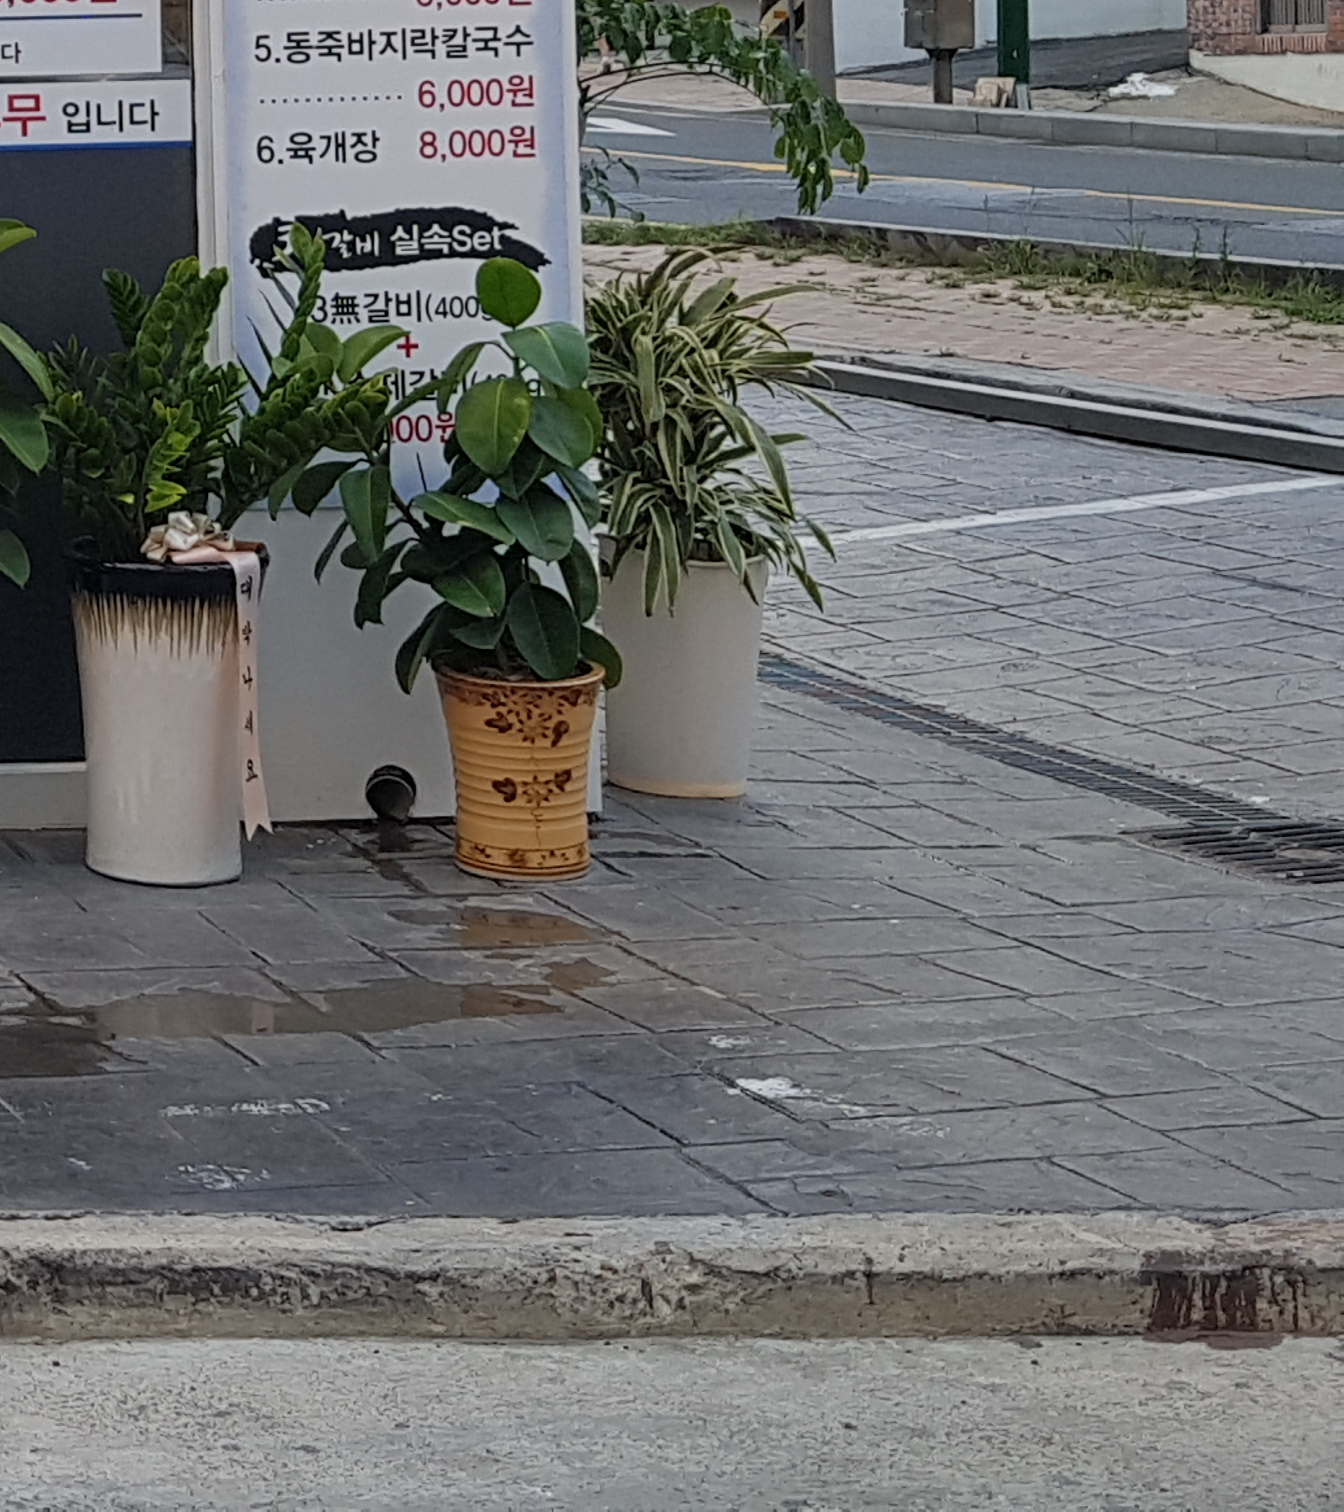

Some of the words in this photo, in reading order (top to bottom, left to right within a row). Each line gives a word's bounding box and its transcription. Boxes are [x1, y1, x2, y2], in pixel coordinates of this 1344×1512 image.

[254, 24, 534, 64] 5.동죽바지락칼국수
[417, 74, 535, 112] 6,000원
[62, 97, 159, 134] 입니다
[256, 129, 380, 165] 6.육개장
[419, 125, 537, 163] 8,000원
[390, 224, 502, 255] 실속Set
